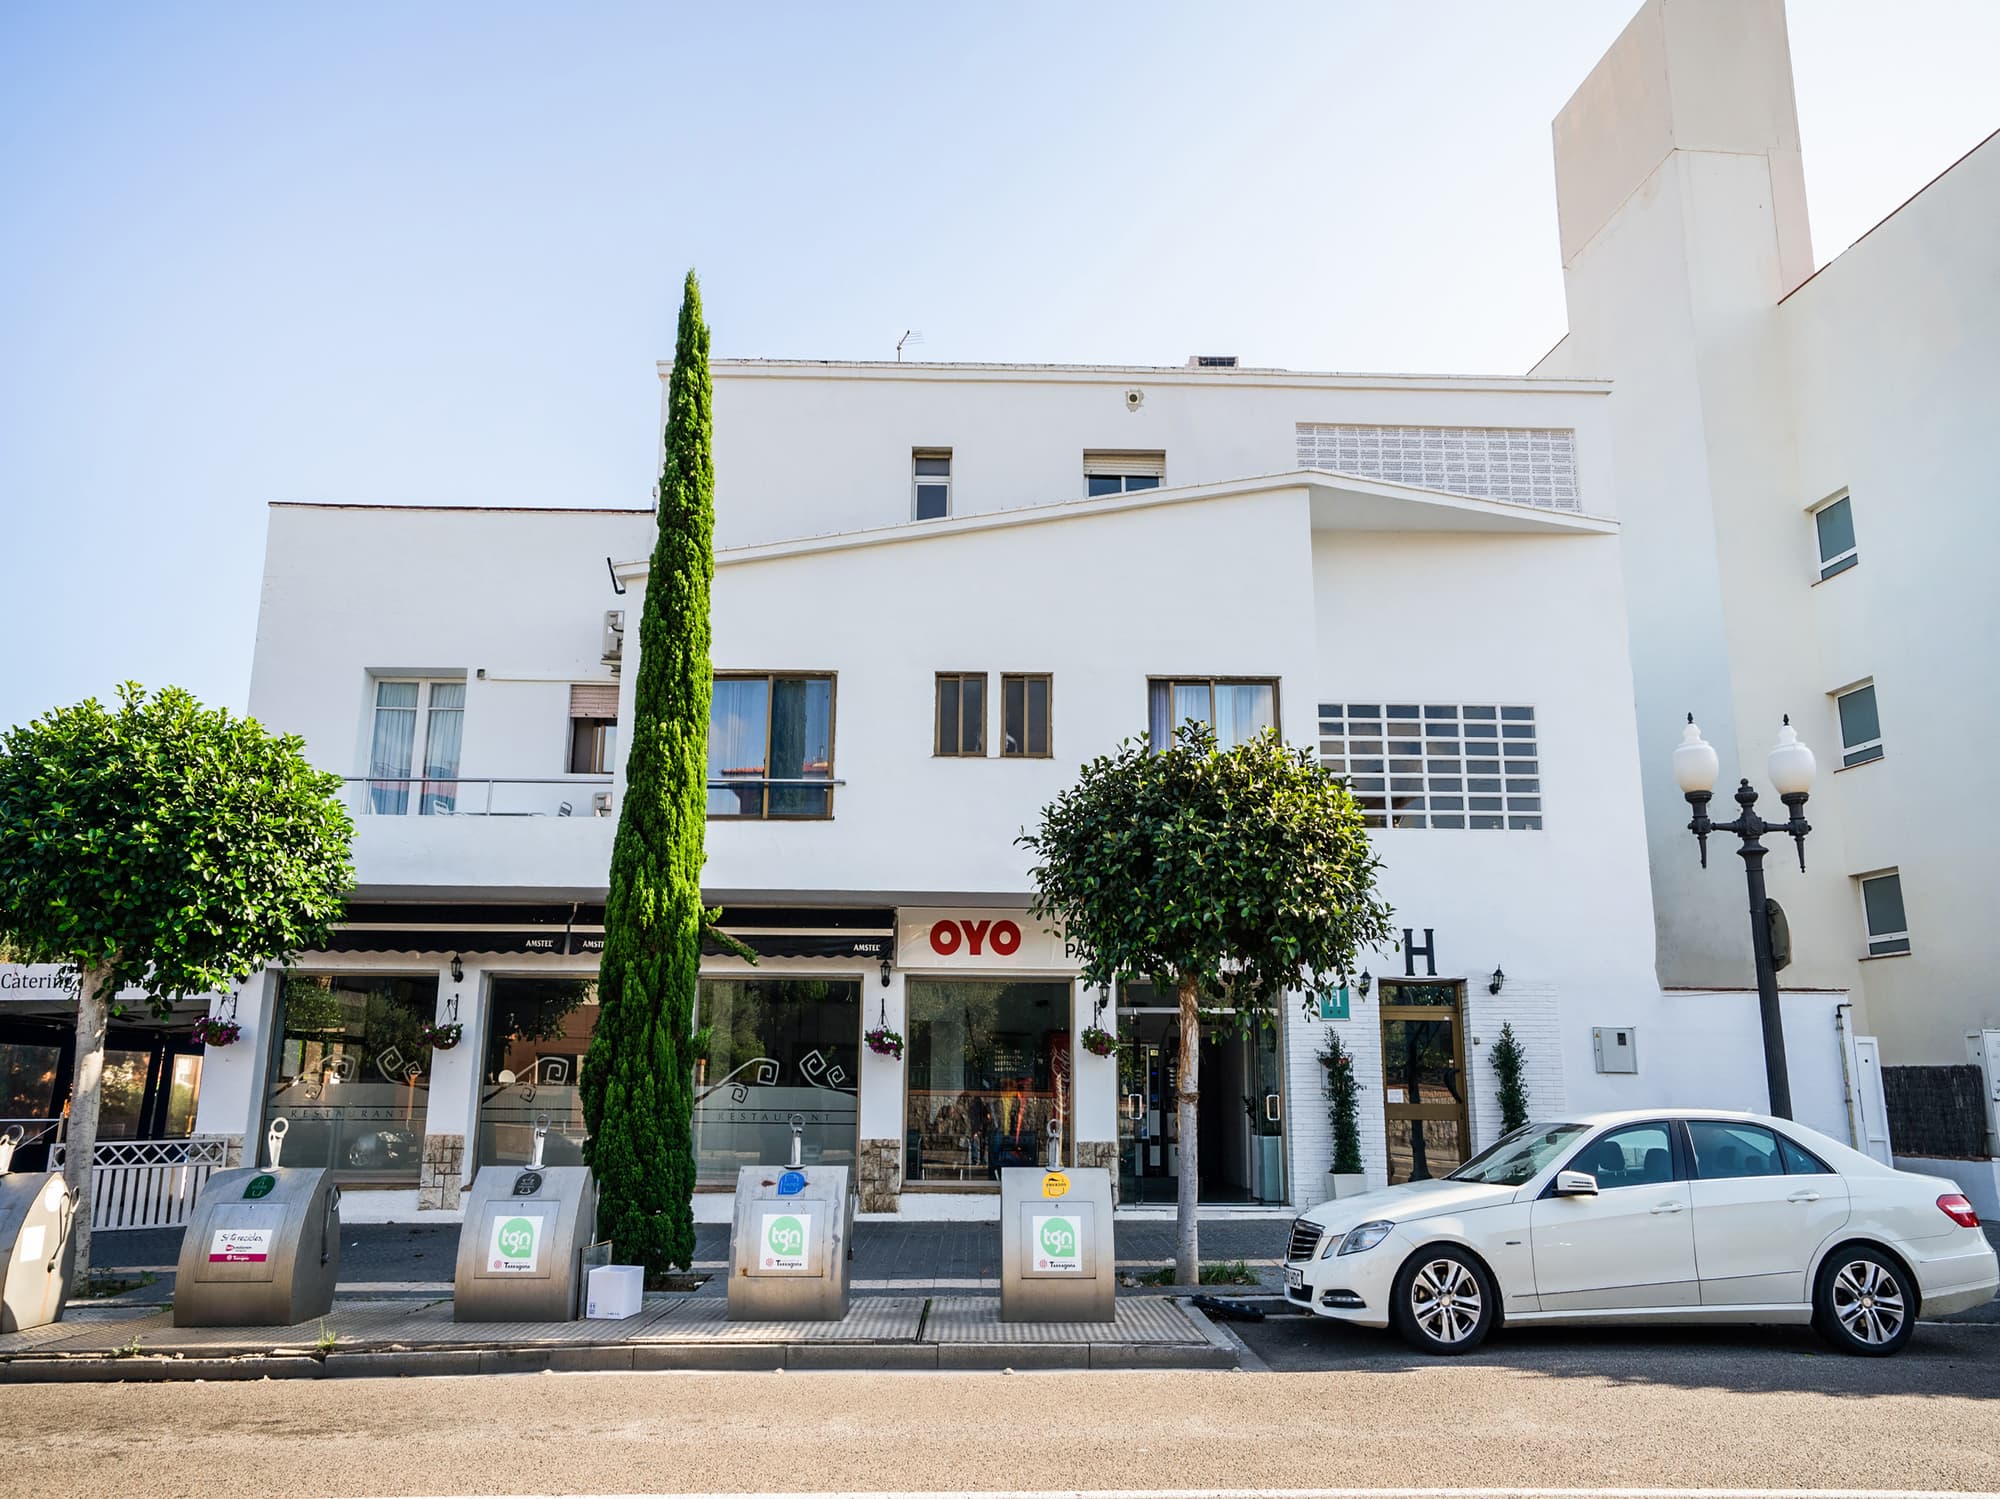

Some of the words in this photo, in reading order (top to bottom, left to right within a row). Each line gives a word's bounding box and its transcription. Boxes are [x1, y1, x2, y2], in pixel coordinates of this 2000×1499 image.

[525, 939, 554, 948] AMSTEL
[582, 940, 605, 949] AMST
[853, 943, 881, 952] AMSTEL
[929, 919, 1021, 956] OYO
[1403, 928, 1437, 976] H
[500, 1228, 531, 1254] tgn
[770, 1226, 801, 1252] tgn
[1042, 1227, 1073, 1254] tgn
